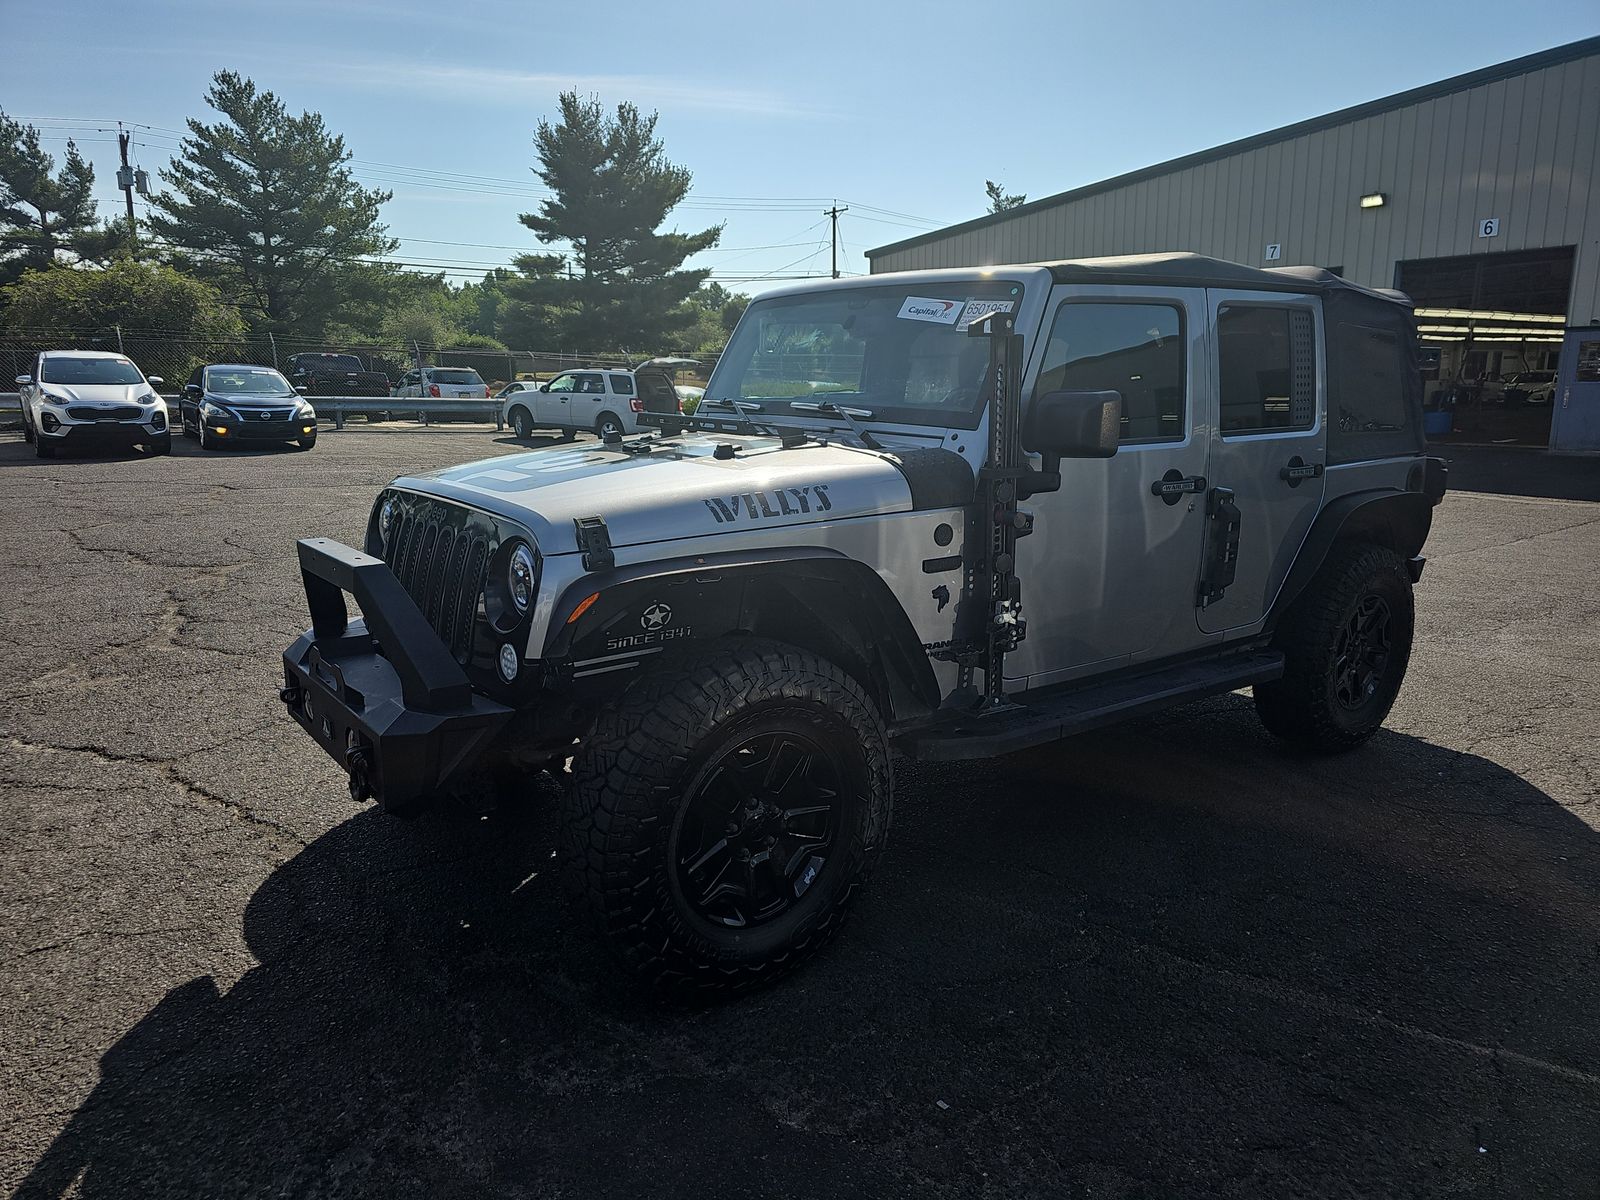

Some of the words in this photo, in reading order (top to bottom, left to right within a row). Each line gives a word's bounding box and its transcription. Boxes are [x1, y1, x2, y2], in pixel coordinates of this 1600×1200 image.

[1484, 220, 1493, 235] 6
[1269, 245, 1278, 258] 7
[701, 484, 832, 523] WILLYS
[607, 632, 655, 650] SINCE
[660, 626, 692, 641] 1941
